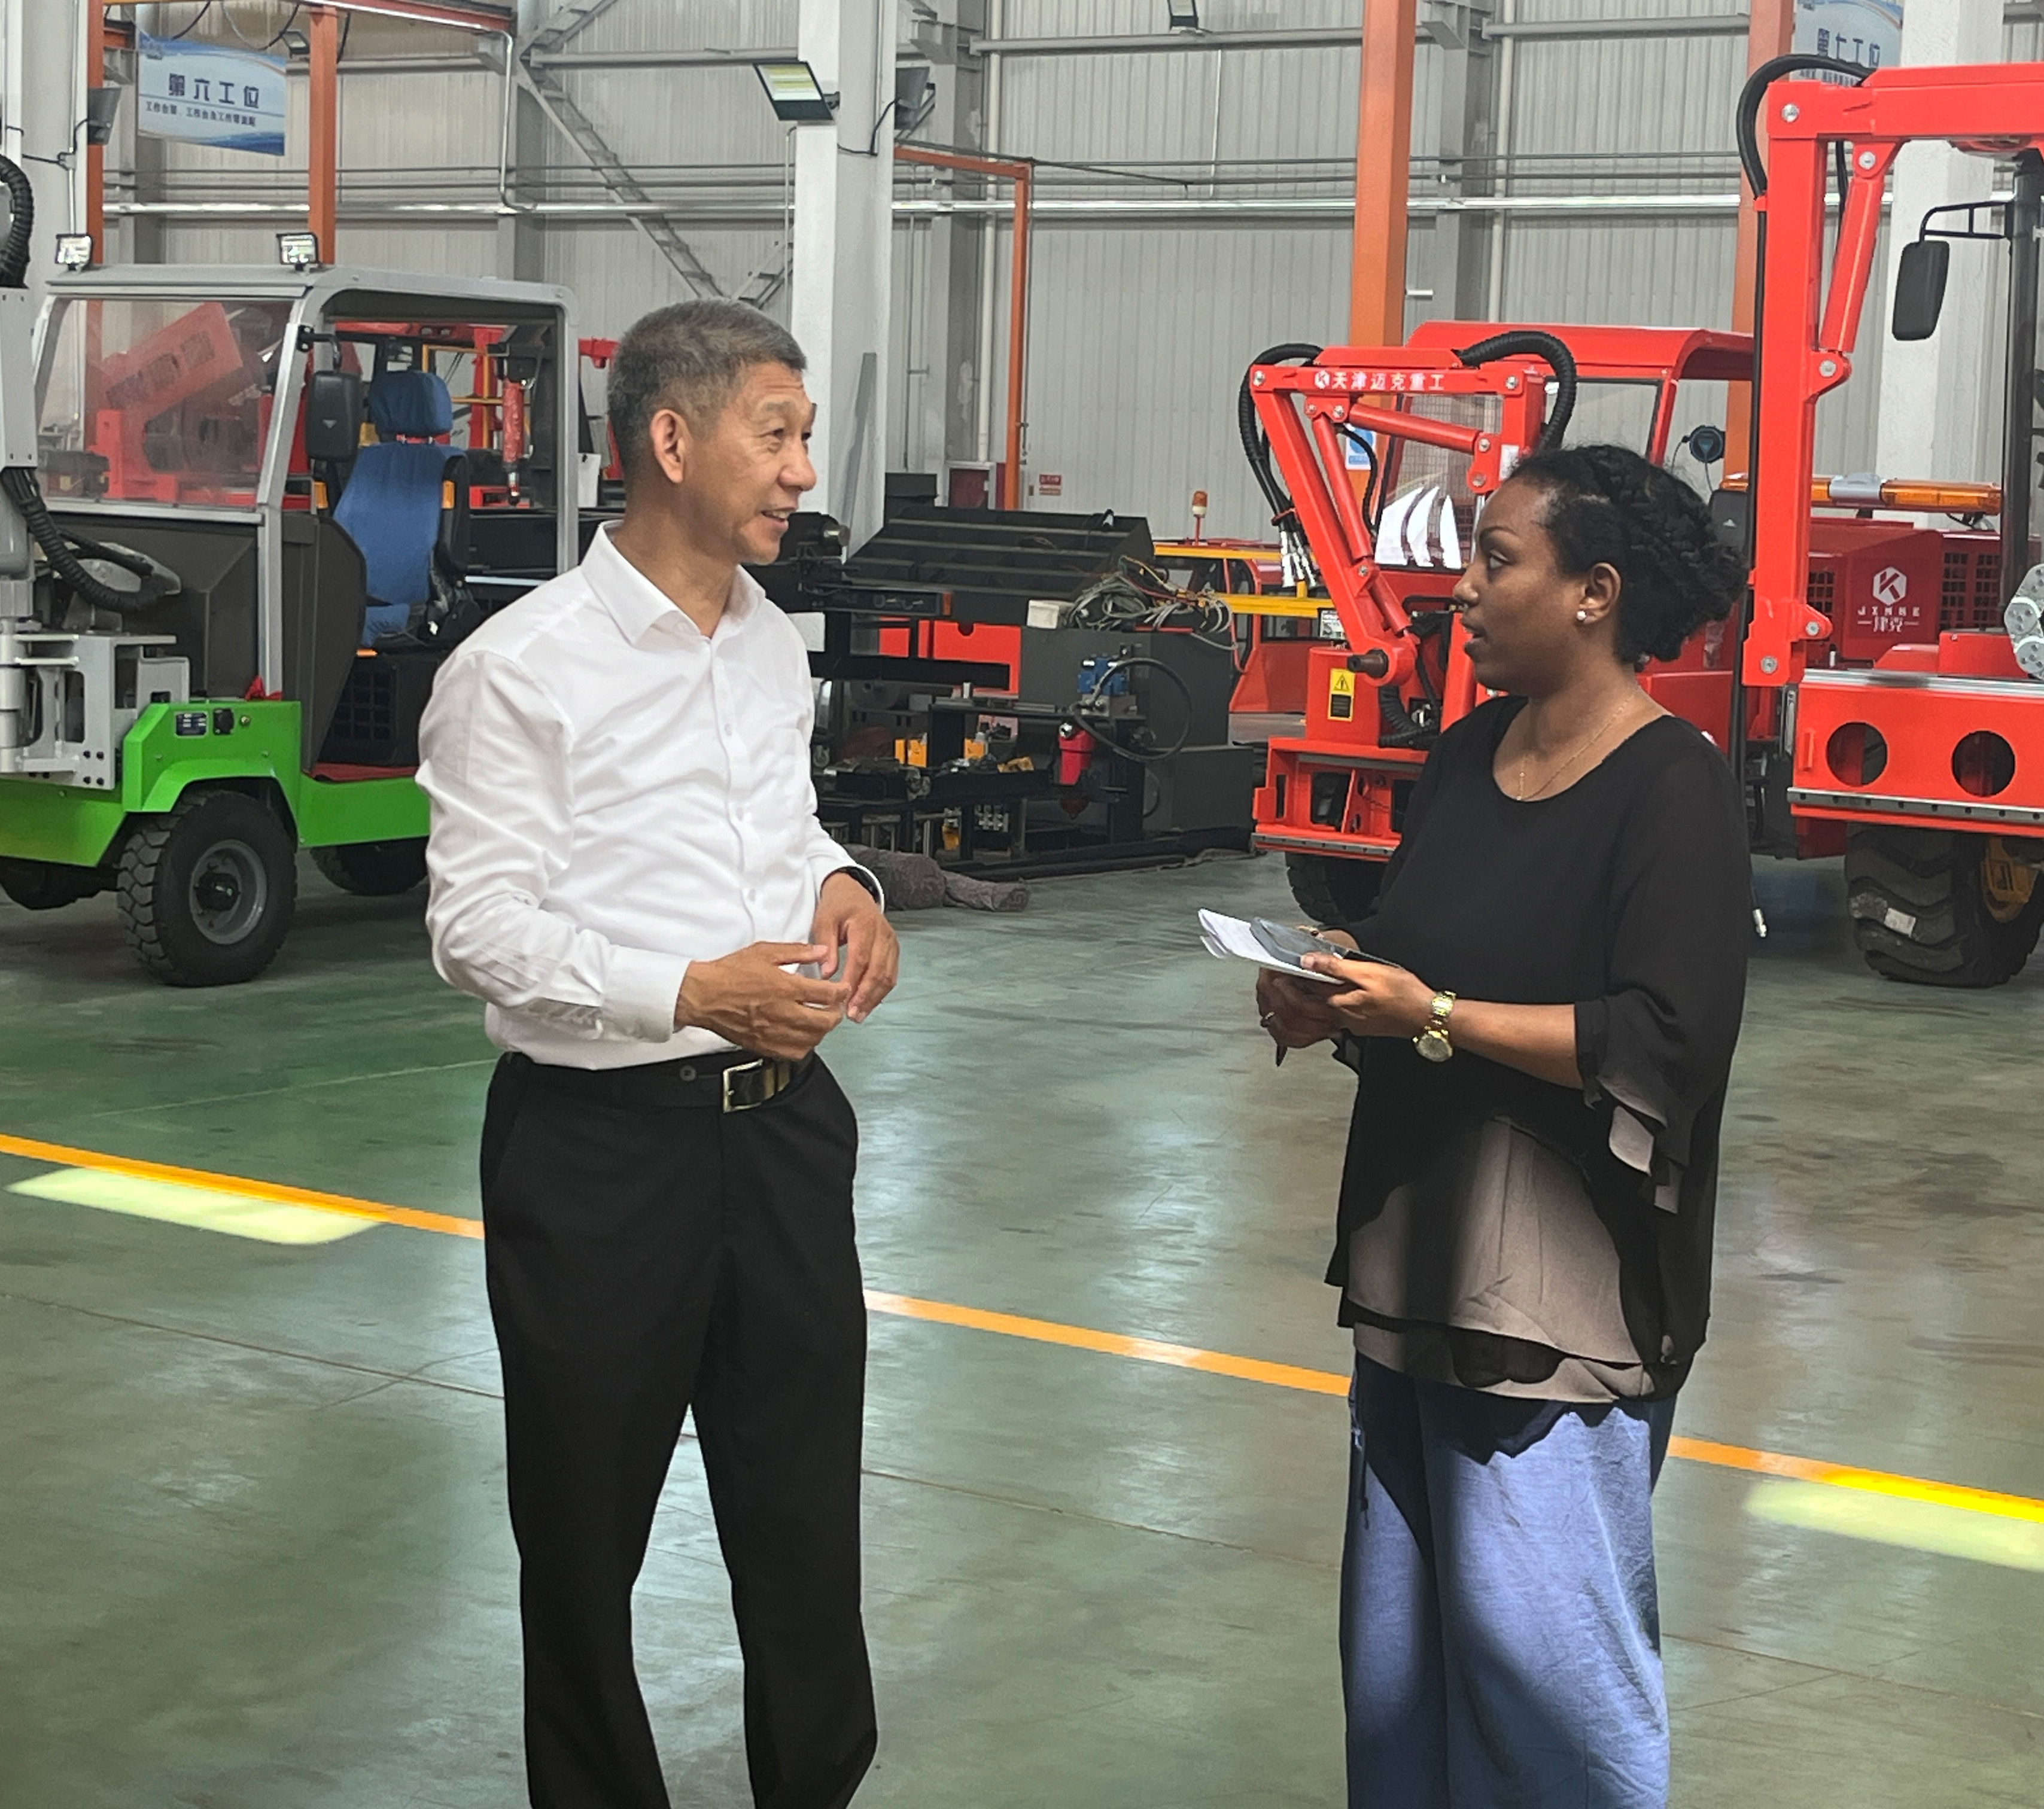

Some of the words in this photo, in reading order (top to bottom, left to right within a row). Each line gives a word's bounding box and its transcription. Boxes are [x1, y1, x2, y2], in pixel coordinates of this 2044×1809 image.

[168, 73, 259, 109] 第六工位
[1331, 371, 1444, 391] 天津迈克重工
